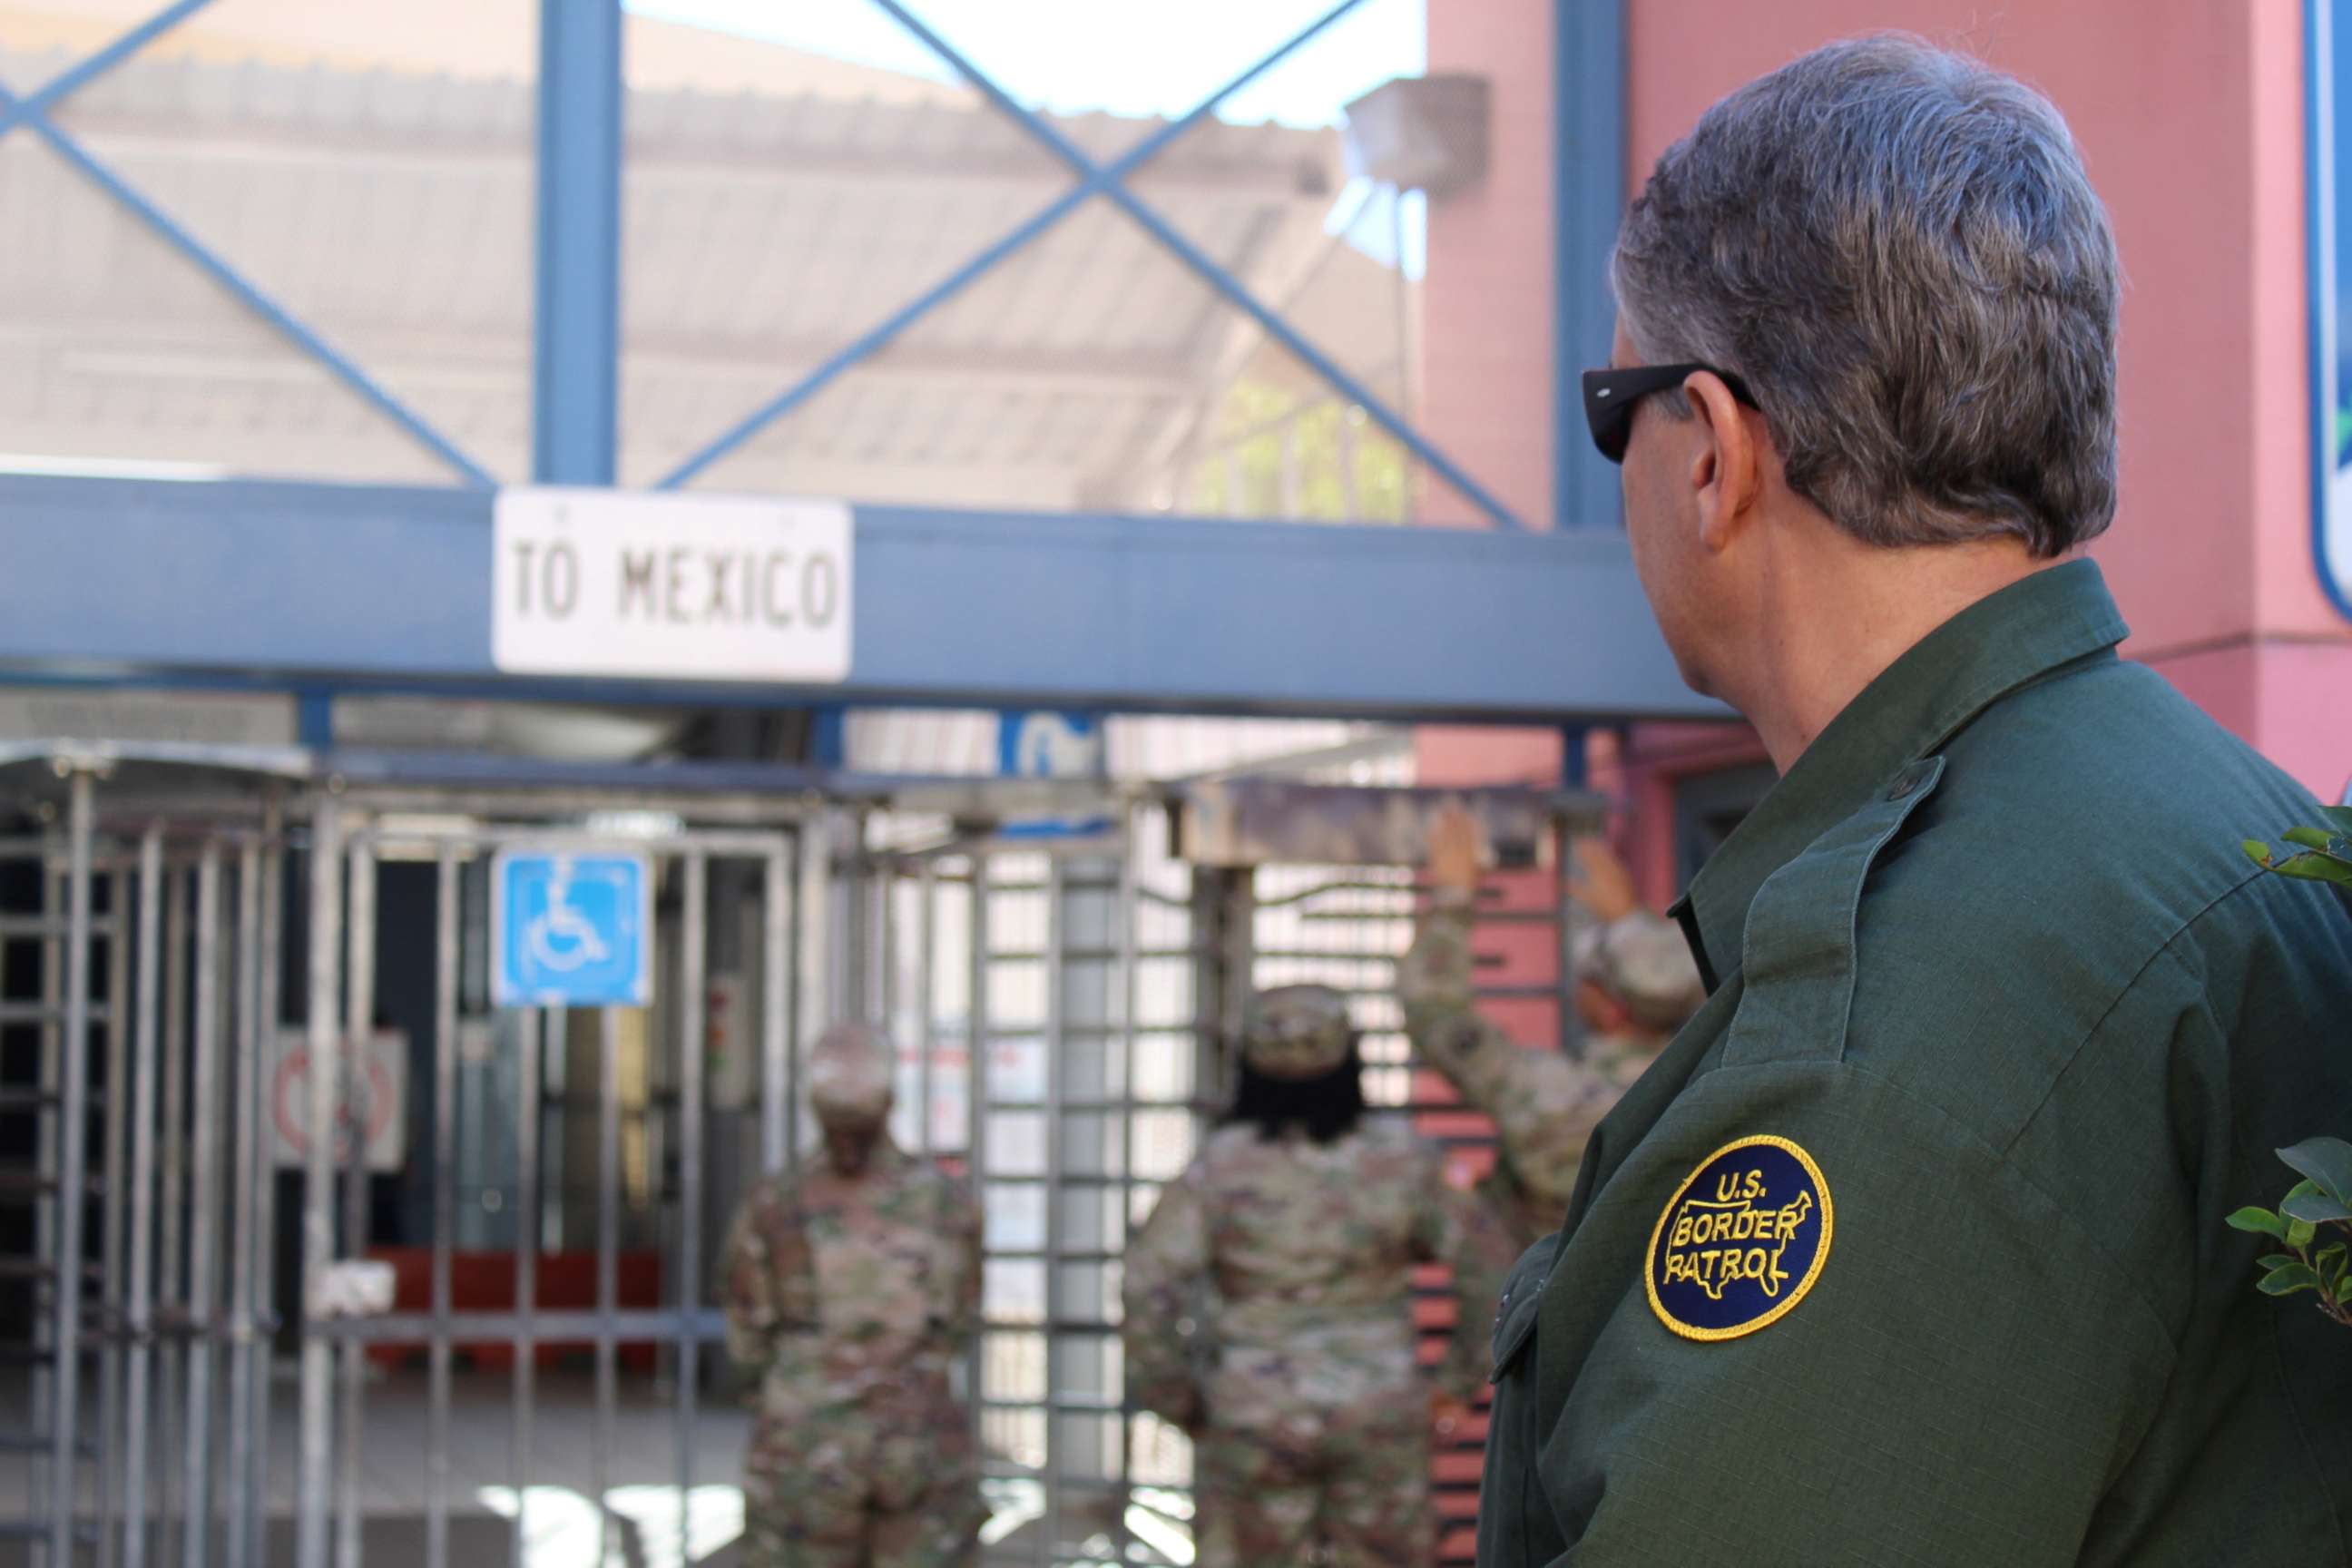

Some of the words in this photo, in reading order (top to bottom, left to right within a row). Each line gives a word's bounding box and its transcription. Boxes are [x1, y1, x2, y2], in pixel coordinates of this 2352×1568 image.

[513, 539, 579, 618] TO
[618, 547, 837, 629] MEXICO
[1716, 1170, 1767, 1201] U.S.
[1672, 1210, 1798, 1247] BORDER
[1663, 1248, 1788, 1285] PATROL
